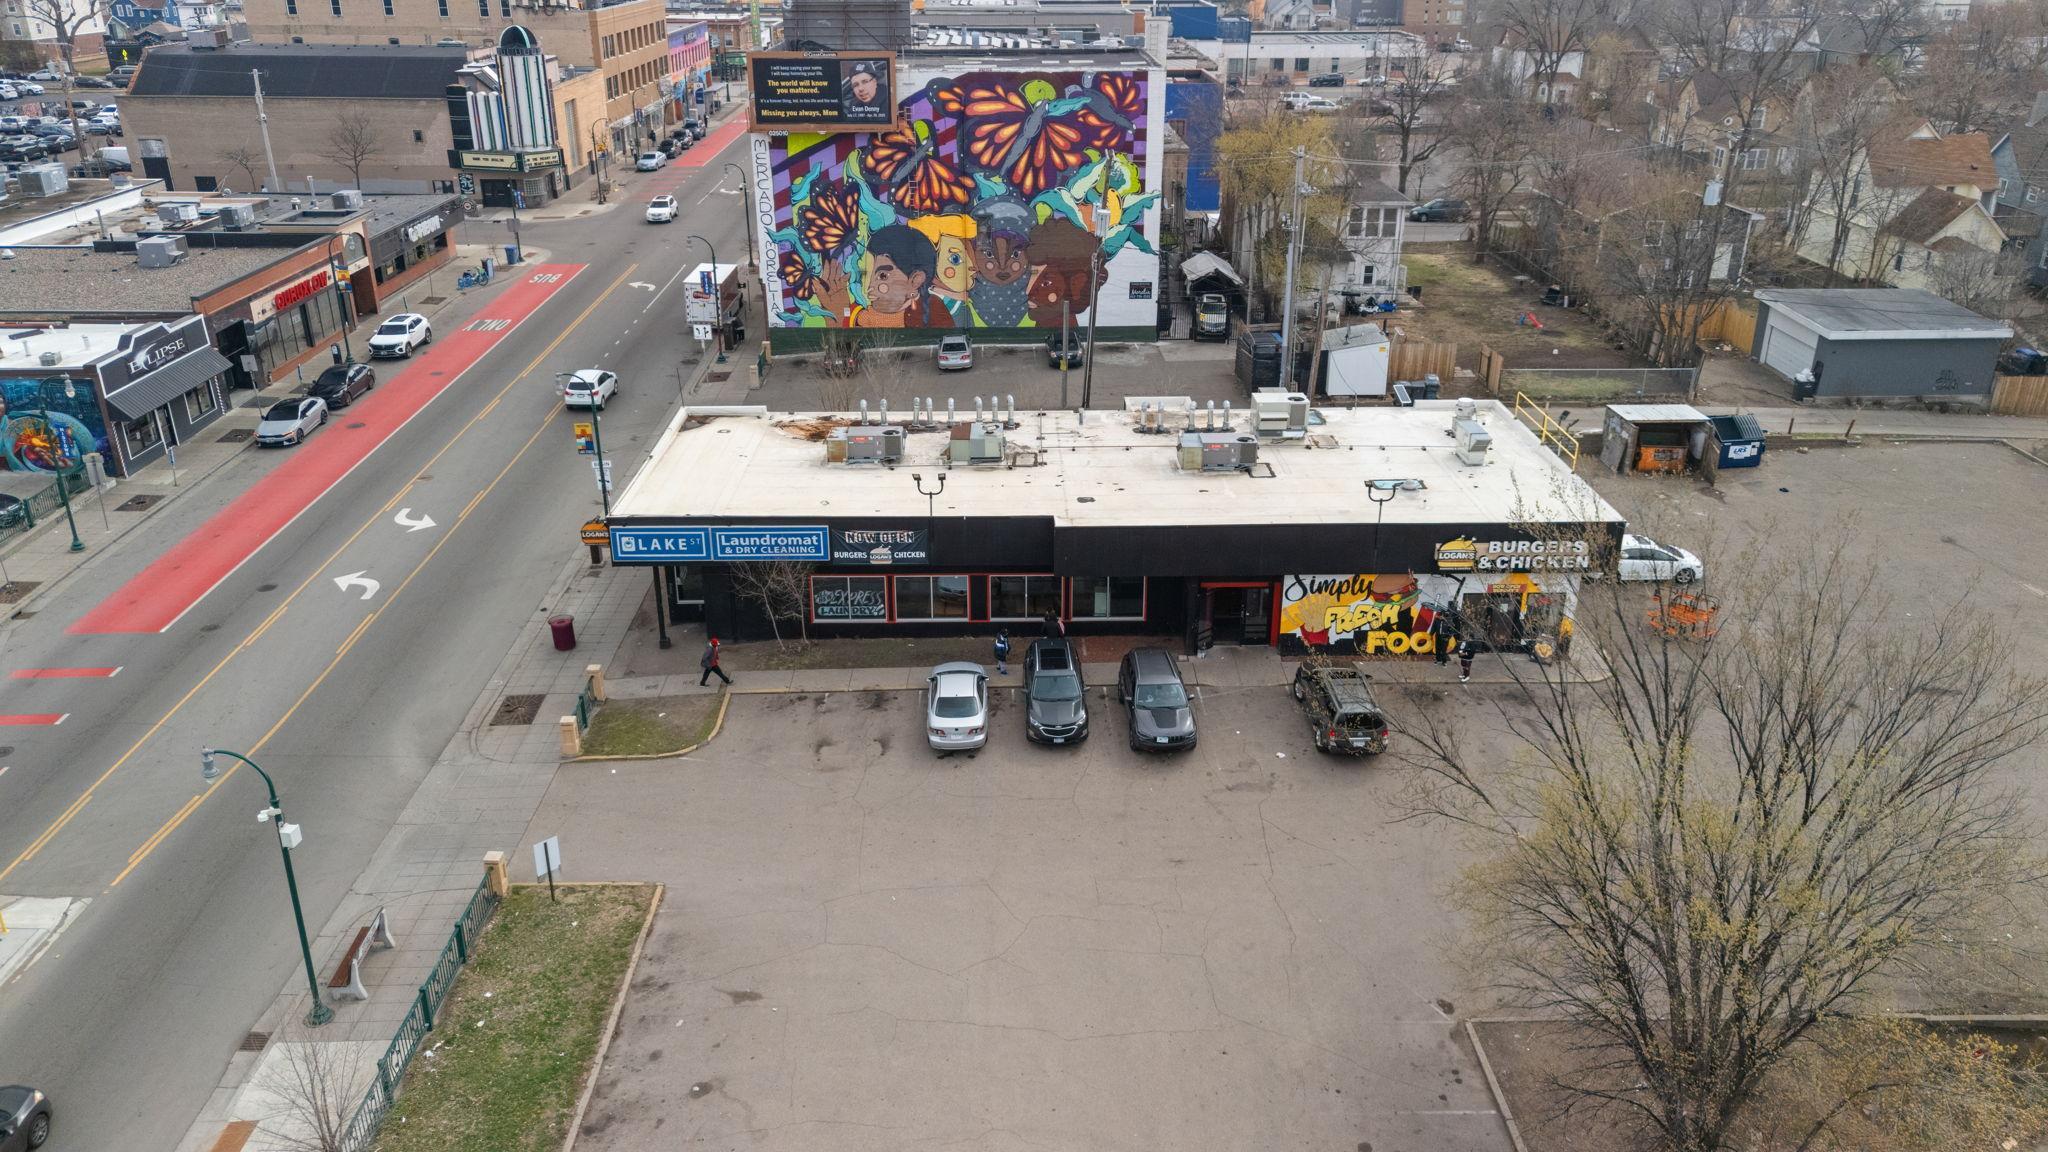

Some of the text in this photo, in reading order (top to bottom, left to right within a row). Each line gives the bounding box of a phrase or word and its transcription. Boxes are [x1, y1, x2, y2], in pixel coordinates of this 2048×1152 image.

[754, 139, 772, 227] MERCADO
[529, 274, 563, 283] BUS
[766, 240, 781, 312] MORELIA
[462, 319, 512, 331] ONLY
[721, 534, 818, 546] Laundromat
[845, 531, 914, 543] NOW OPEN
[638, 538, 688, 550] LAKE
[1489, 541, 1585, 553] BURGERS
[1478, 556, 1589, 569] & CHICKEN
[1285, 574, 1373, 601] Simply
[832, 590, 882, 605] EXPRESS
[1324, 604, 1400, 634] FRESH
